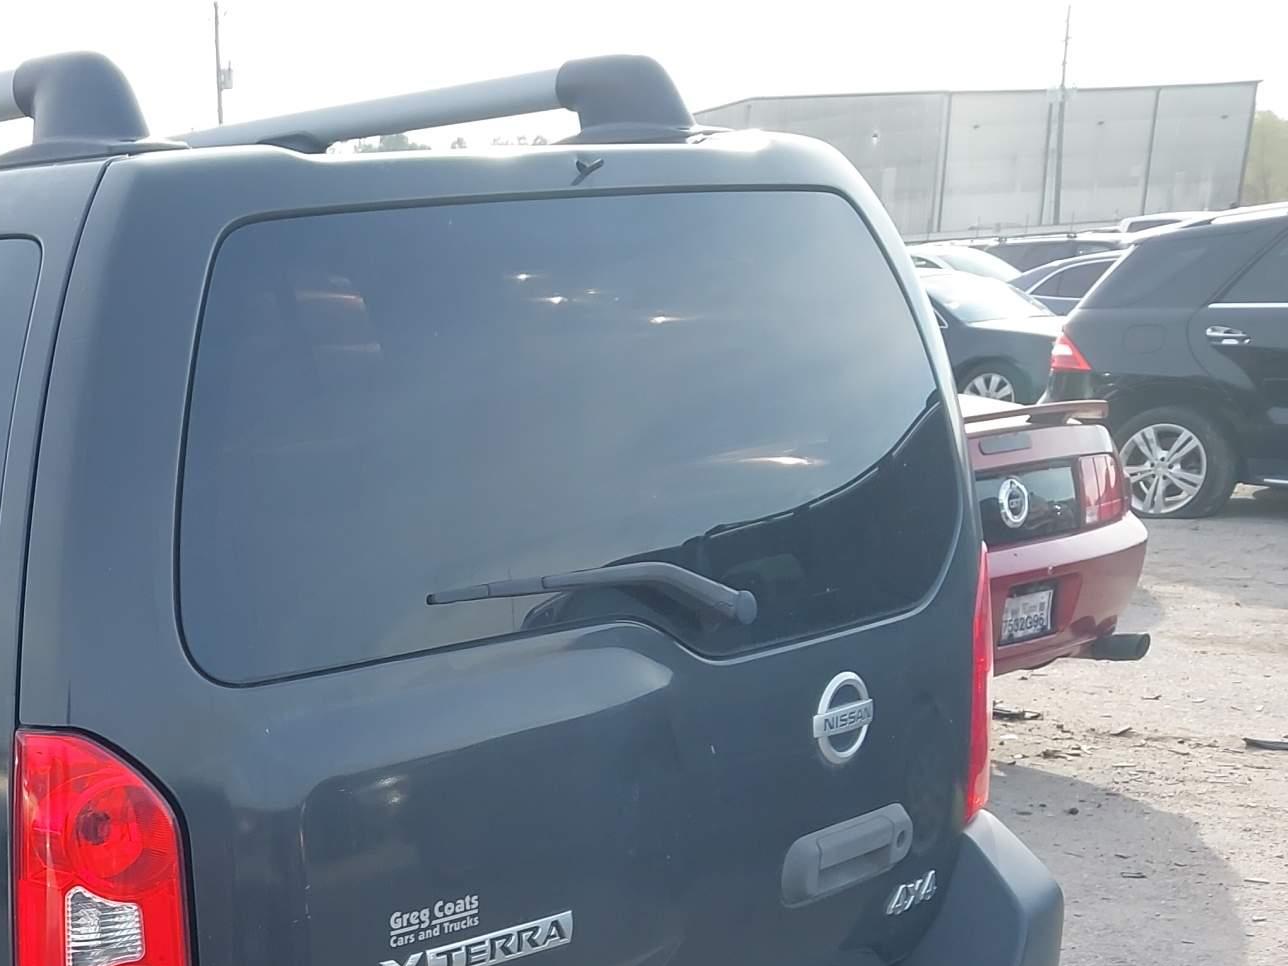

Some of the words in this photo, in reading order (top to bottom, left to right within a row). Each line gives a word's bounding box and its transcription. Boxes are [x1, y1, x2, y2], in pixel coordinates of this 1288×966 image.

[823, 705, 872, 732] NISSAN
[390, 908, 430, 929] Greg
[434, 894, 479, 918] Coats
[389, 933, 416, 948] Cars
[418, 925, 440, 941] and
[443, 916, 479, 934] Trucks
